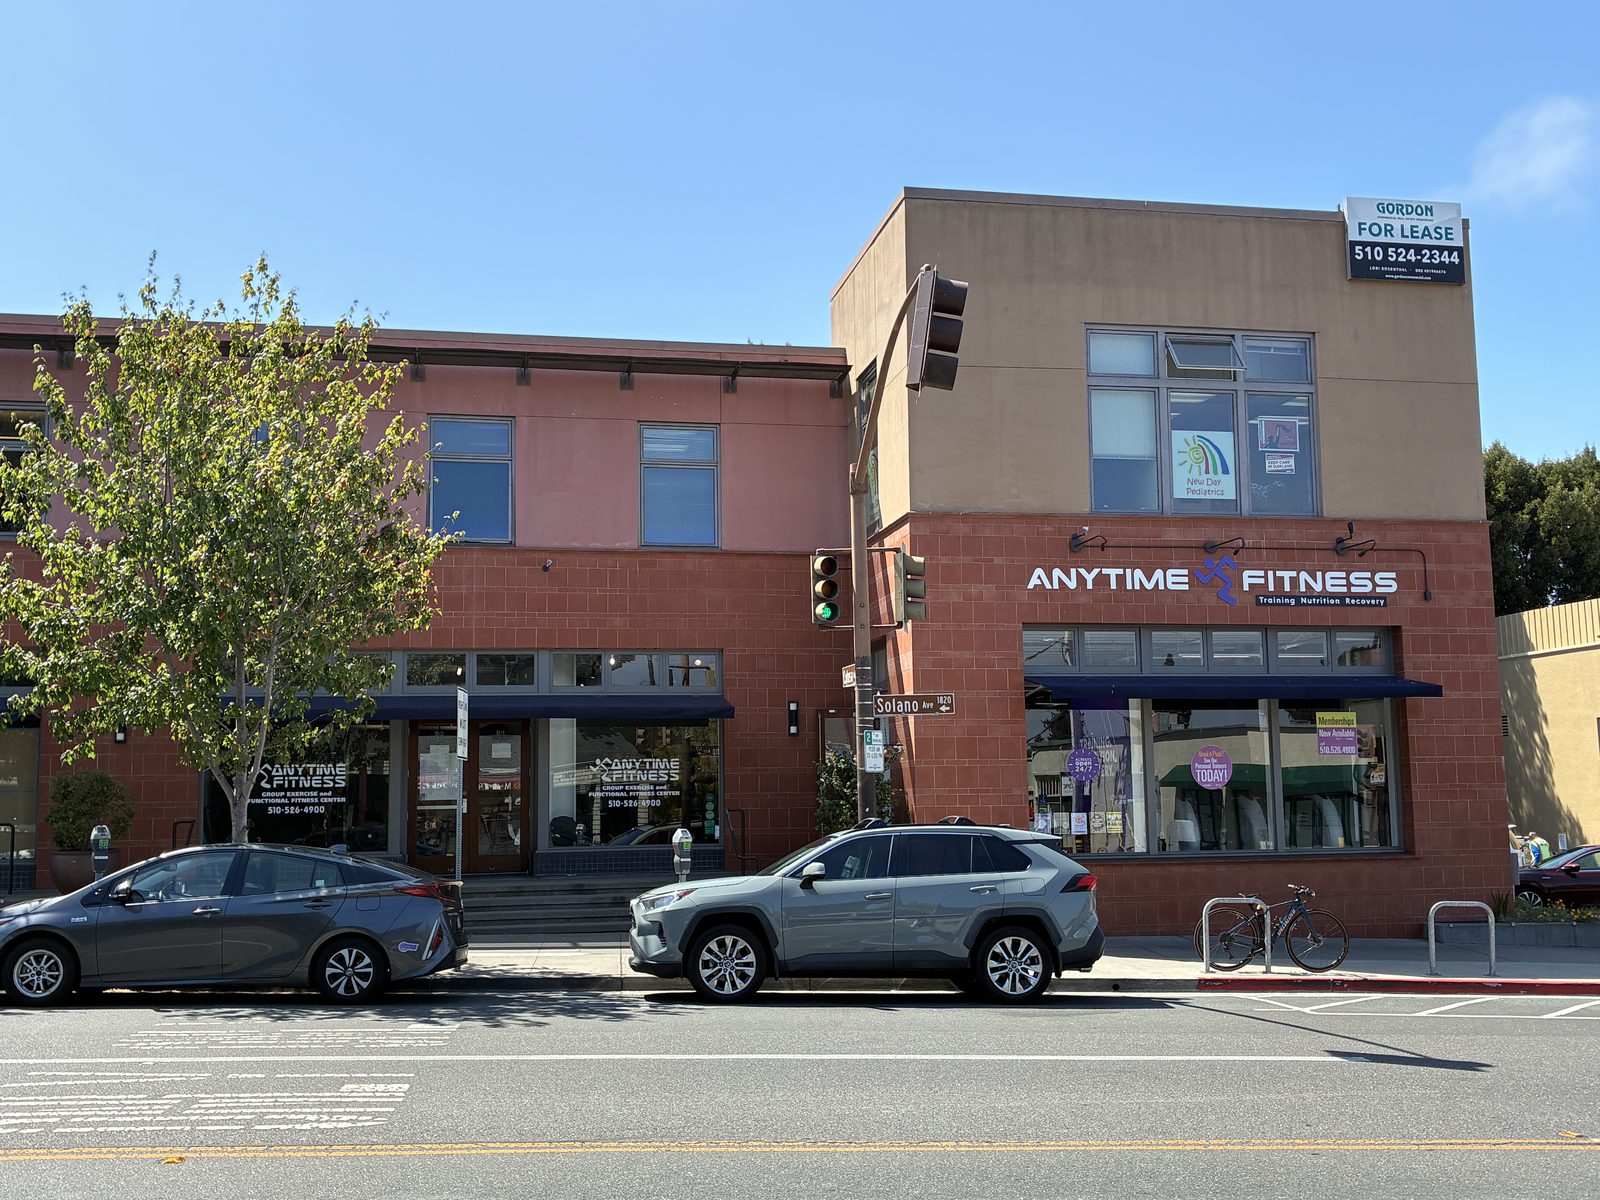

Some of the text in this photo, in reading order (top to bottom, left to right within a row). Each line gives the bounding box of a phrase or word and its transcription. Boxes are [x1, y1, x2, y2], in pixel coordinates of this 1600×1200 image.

[1376, 202, 1433, 217] GORDON
[1358, 222, 1454, 241] FOR LEASE
[1354, 246, 1460, 265] 510 524-2344
[1187, 478, 1222, 487] New Day
[1186, 488, 1224, 496] Pediatrics
[1026, 567, 1398, 594] ANYTIME FITNESS
[1259, 596, 1296, 606] Training
[1345, 597, 1384, 606] Recovery
[877, 698, 918, 713] Solano
[936, 696, 952, 704] 1820
[1318, 716, 1354, 726] Memberships
[866, 733, 870, 742] 2
[1319, 729, 1355, 737] Now Available
[272, 763, 346, 775] ANYTIME
[611, 758, 680, 769] ANYTIME
[612, 770, 680, 781] FITNESS
[1195, 769, 1227, 782] TODAY!
[273, 776, 346, 788] FITNESS
